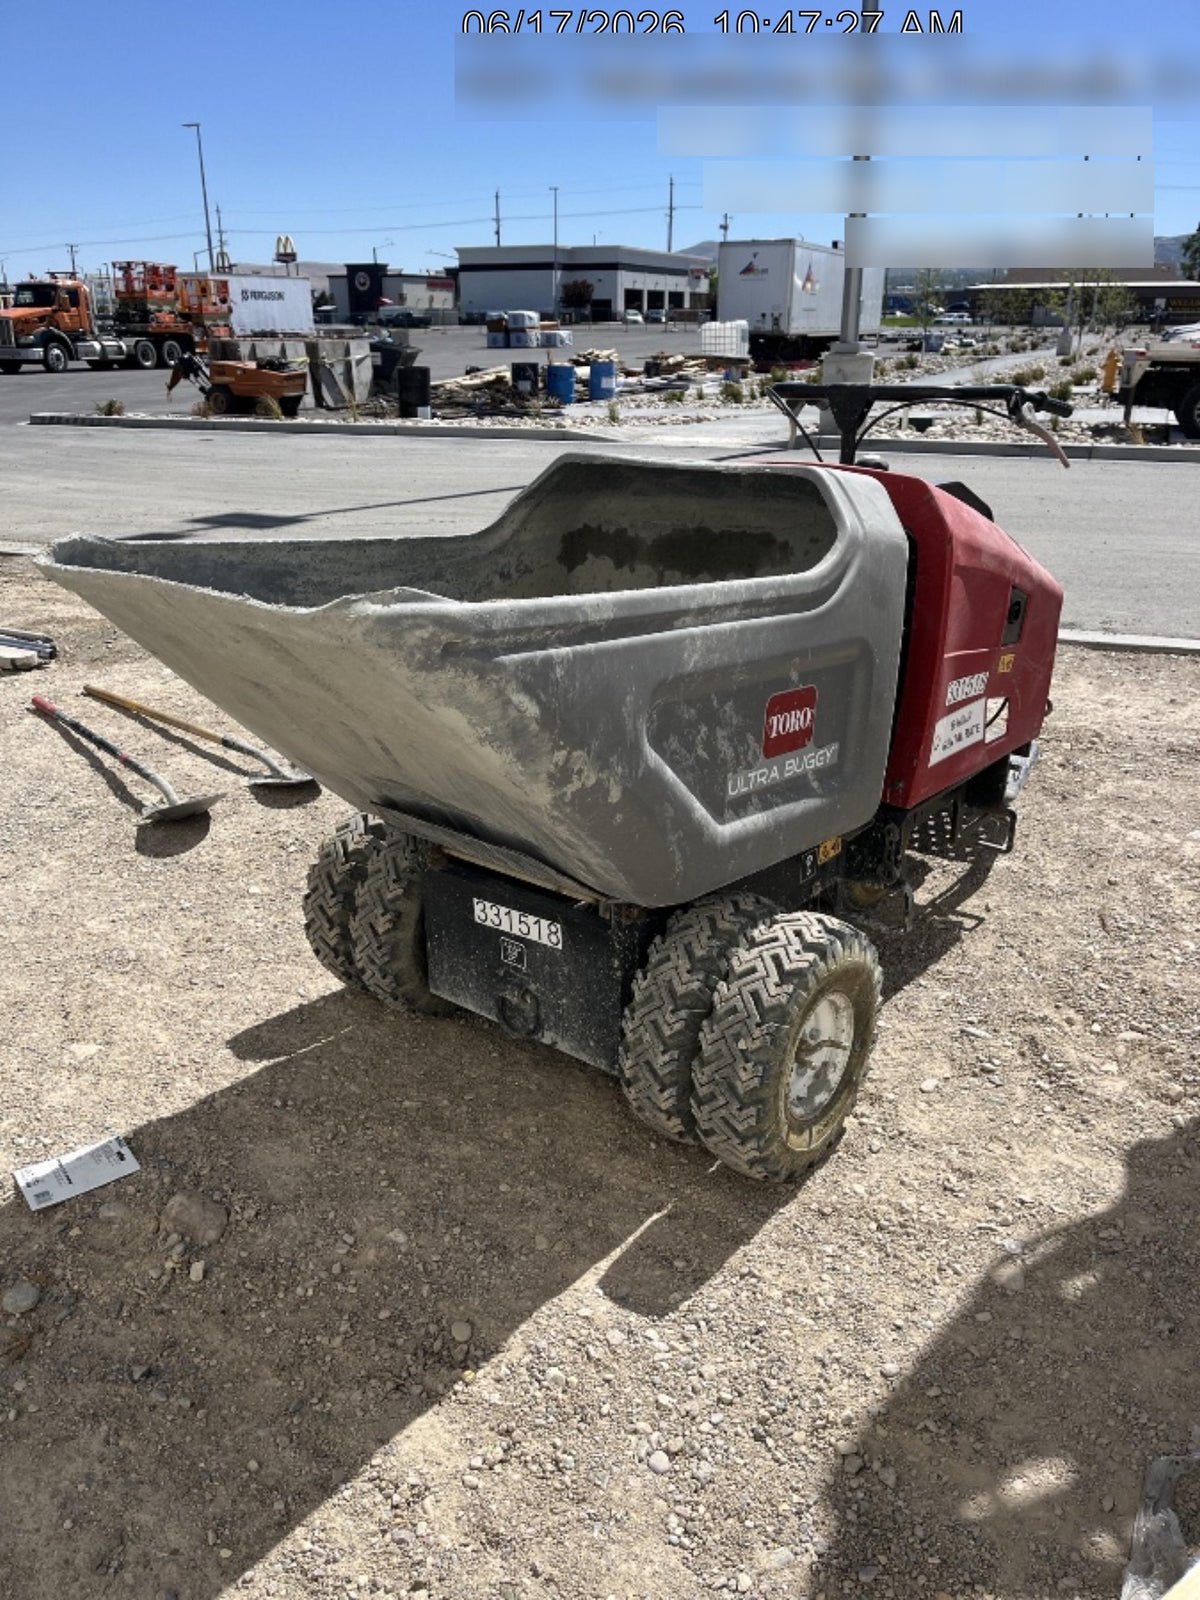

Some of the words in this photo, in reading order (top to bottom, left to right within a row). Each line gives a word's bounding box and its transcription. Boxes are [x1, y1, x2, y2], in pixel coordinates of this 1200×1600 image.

[250, 291, 285, 301] FERGUSON
[769, 707, 813, 738] TORO
[728, 765, 780, 796] ULTRA
[475, 900, 561, 947] 331518
